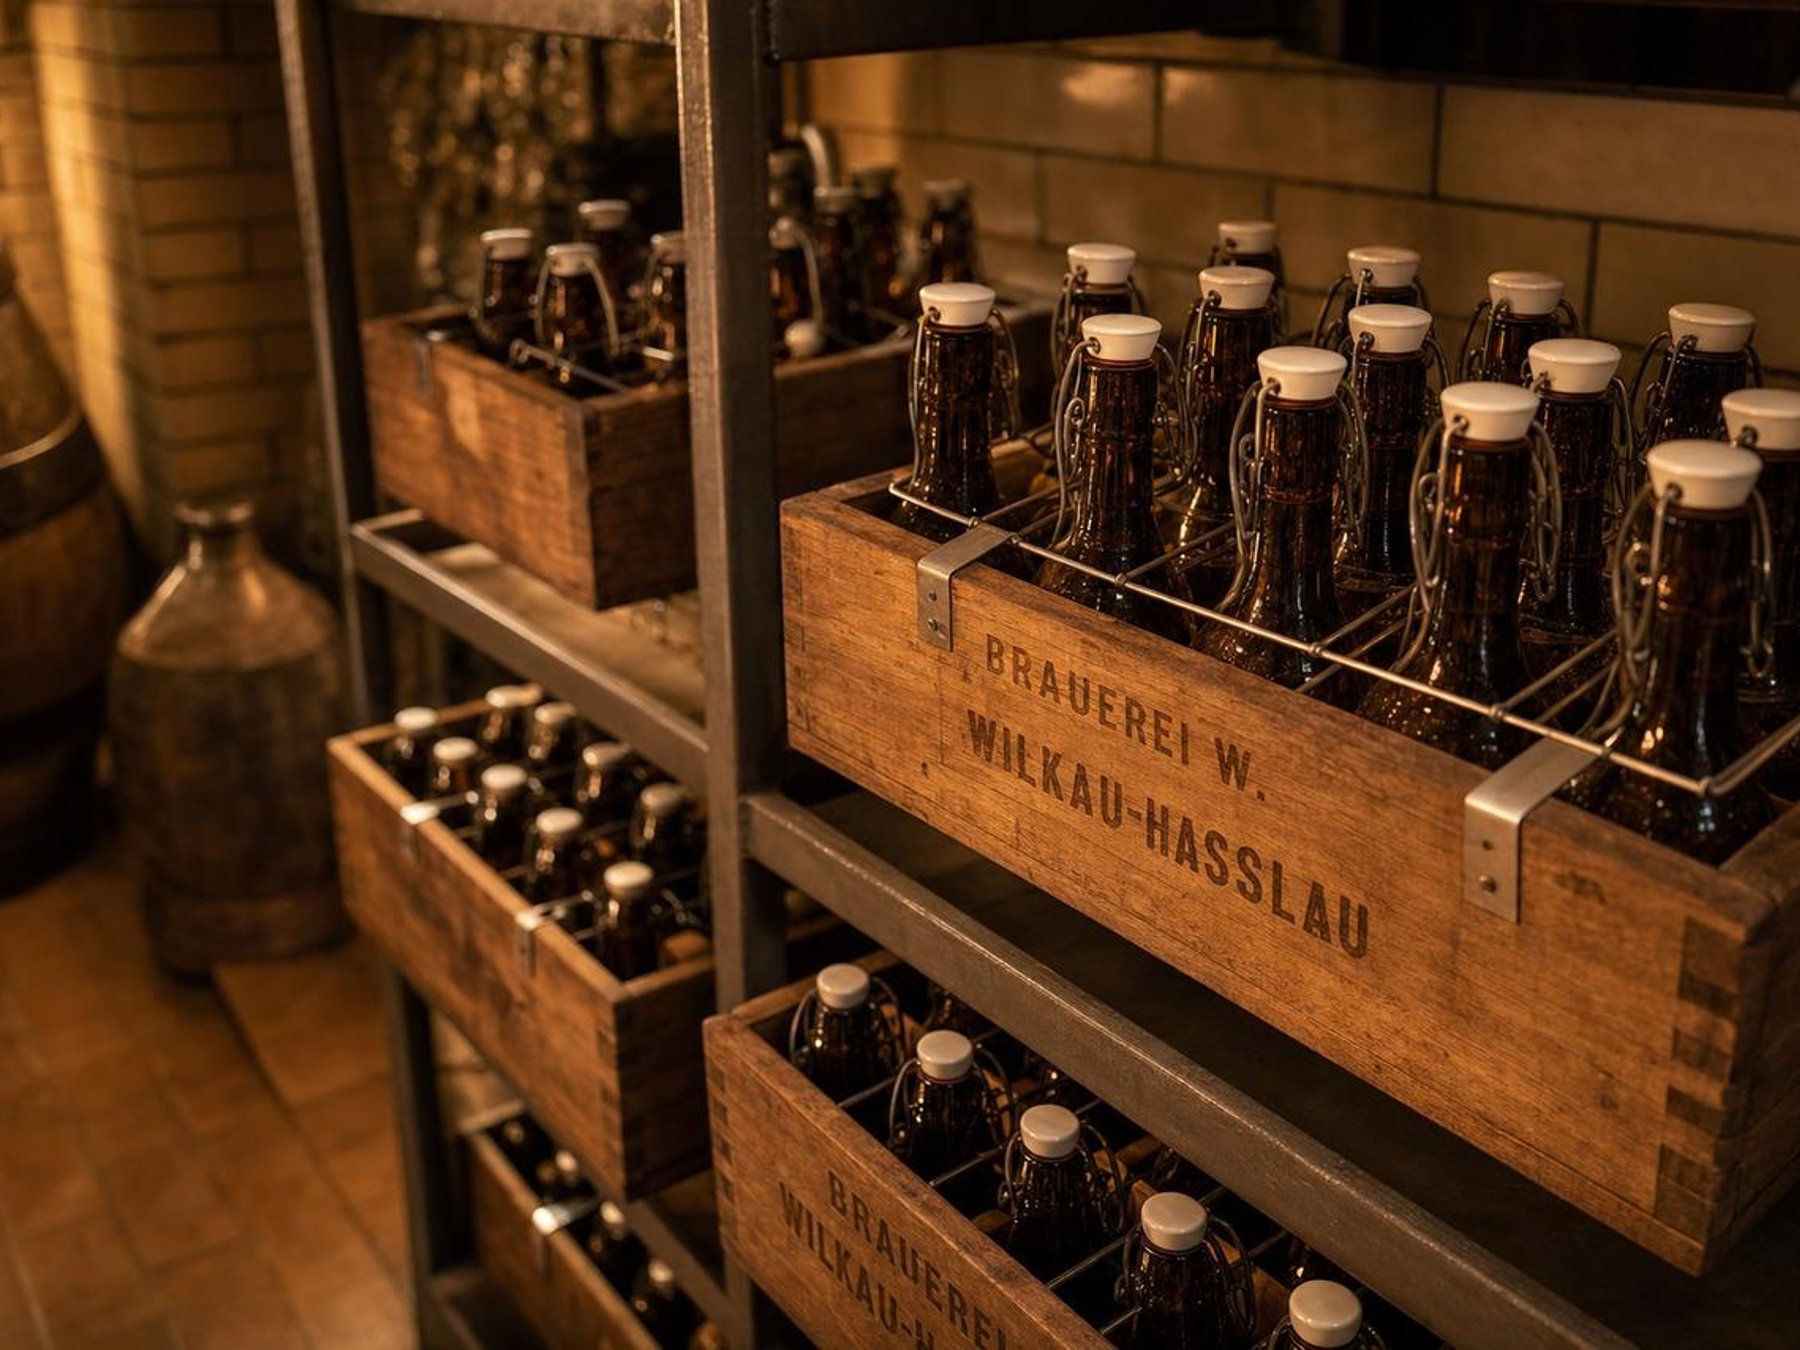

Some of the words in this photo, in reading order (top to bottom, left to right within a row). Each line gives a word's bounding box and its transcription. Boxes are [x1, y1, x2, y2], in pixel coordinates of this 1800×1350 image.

[986, 633, 1190, 766] BRAUEREI
[1214, 736, 1266, 802] W.
[967, 708, 1370, 960] WILKAU-HASSLAU
